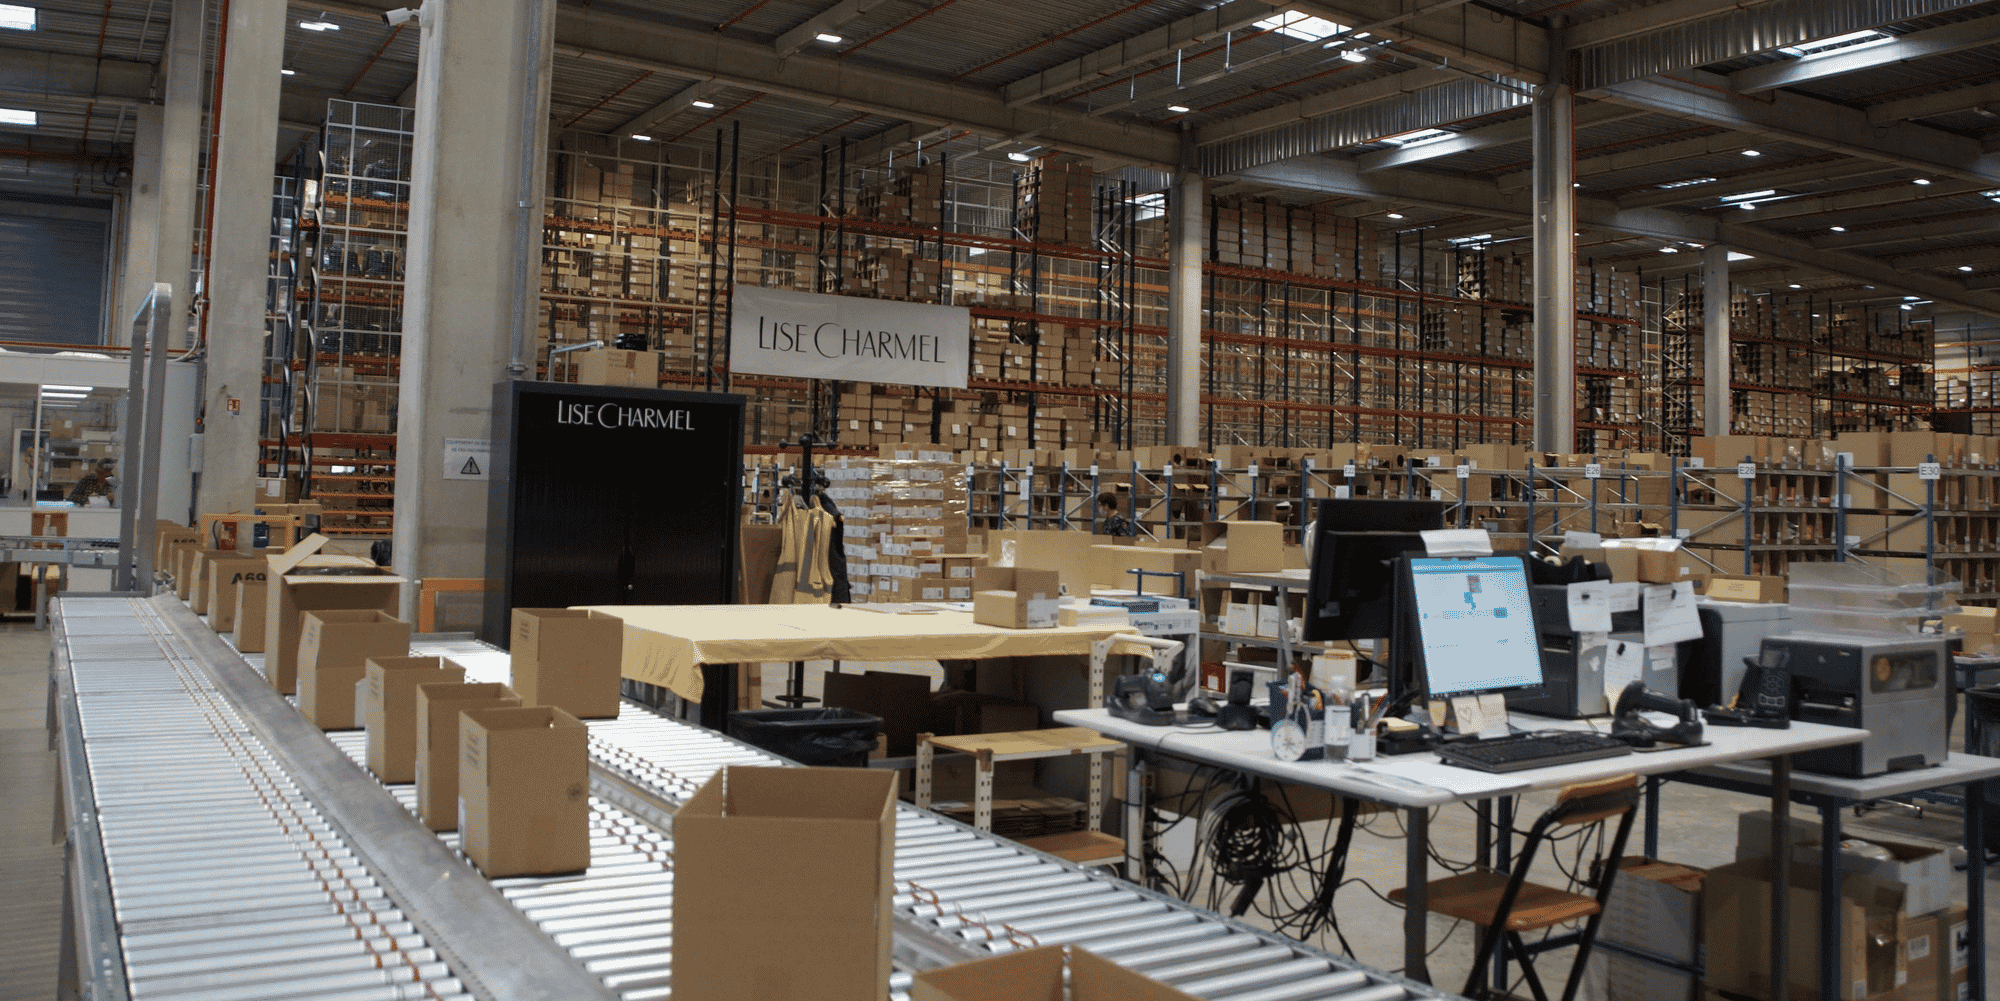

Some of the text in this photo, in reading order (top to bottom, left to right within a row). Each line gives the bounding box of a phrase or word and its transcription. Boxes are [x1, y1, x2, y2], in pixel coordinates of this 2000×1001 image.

[759, 316, 946, 363] LISE CHARMEL
[558, 400, 695, 431] LISE CHARMEL
[1921, 466, 1939, 476] E30
